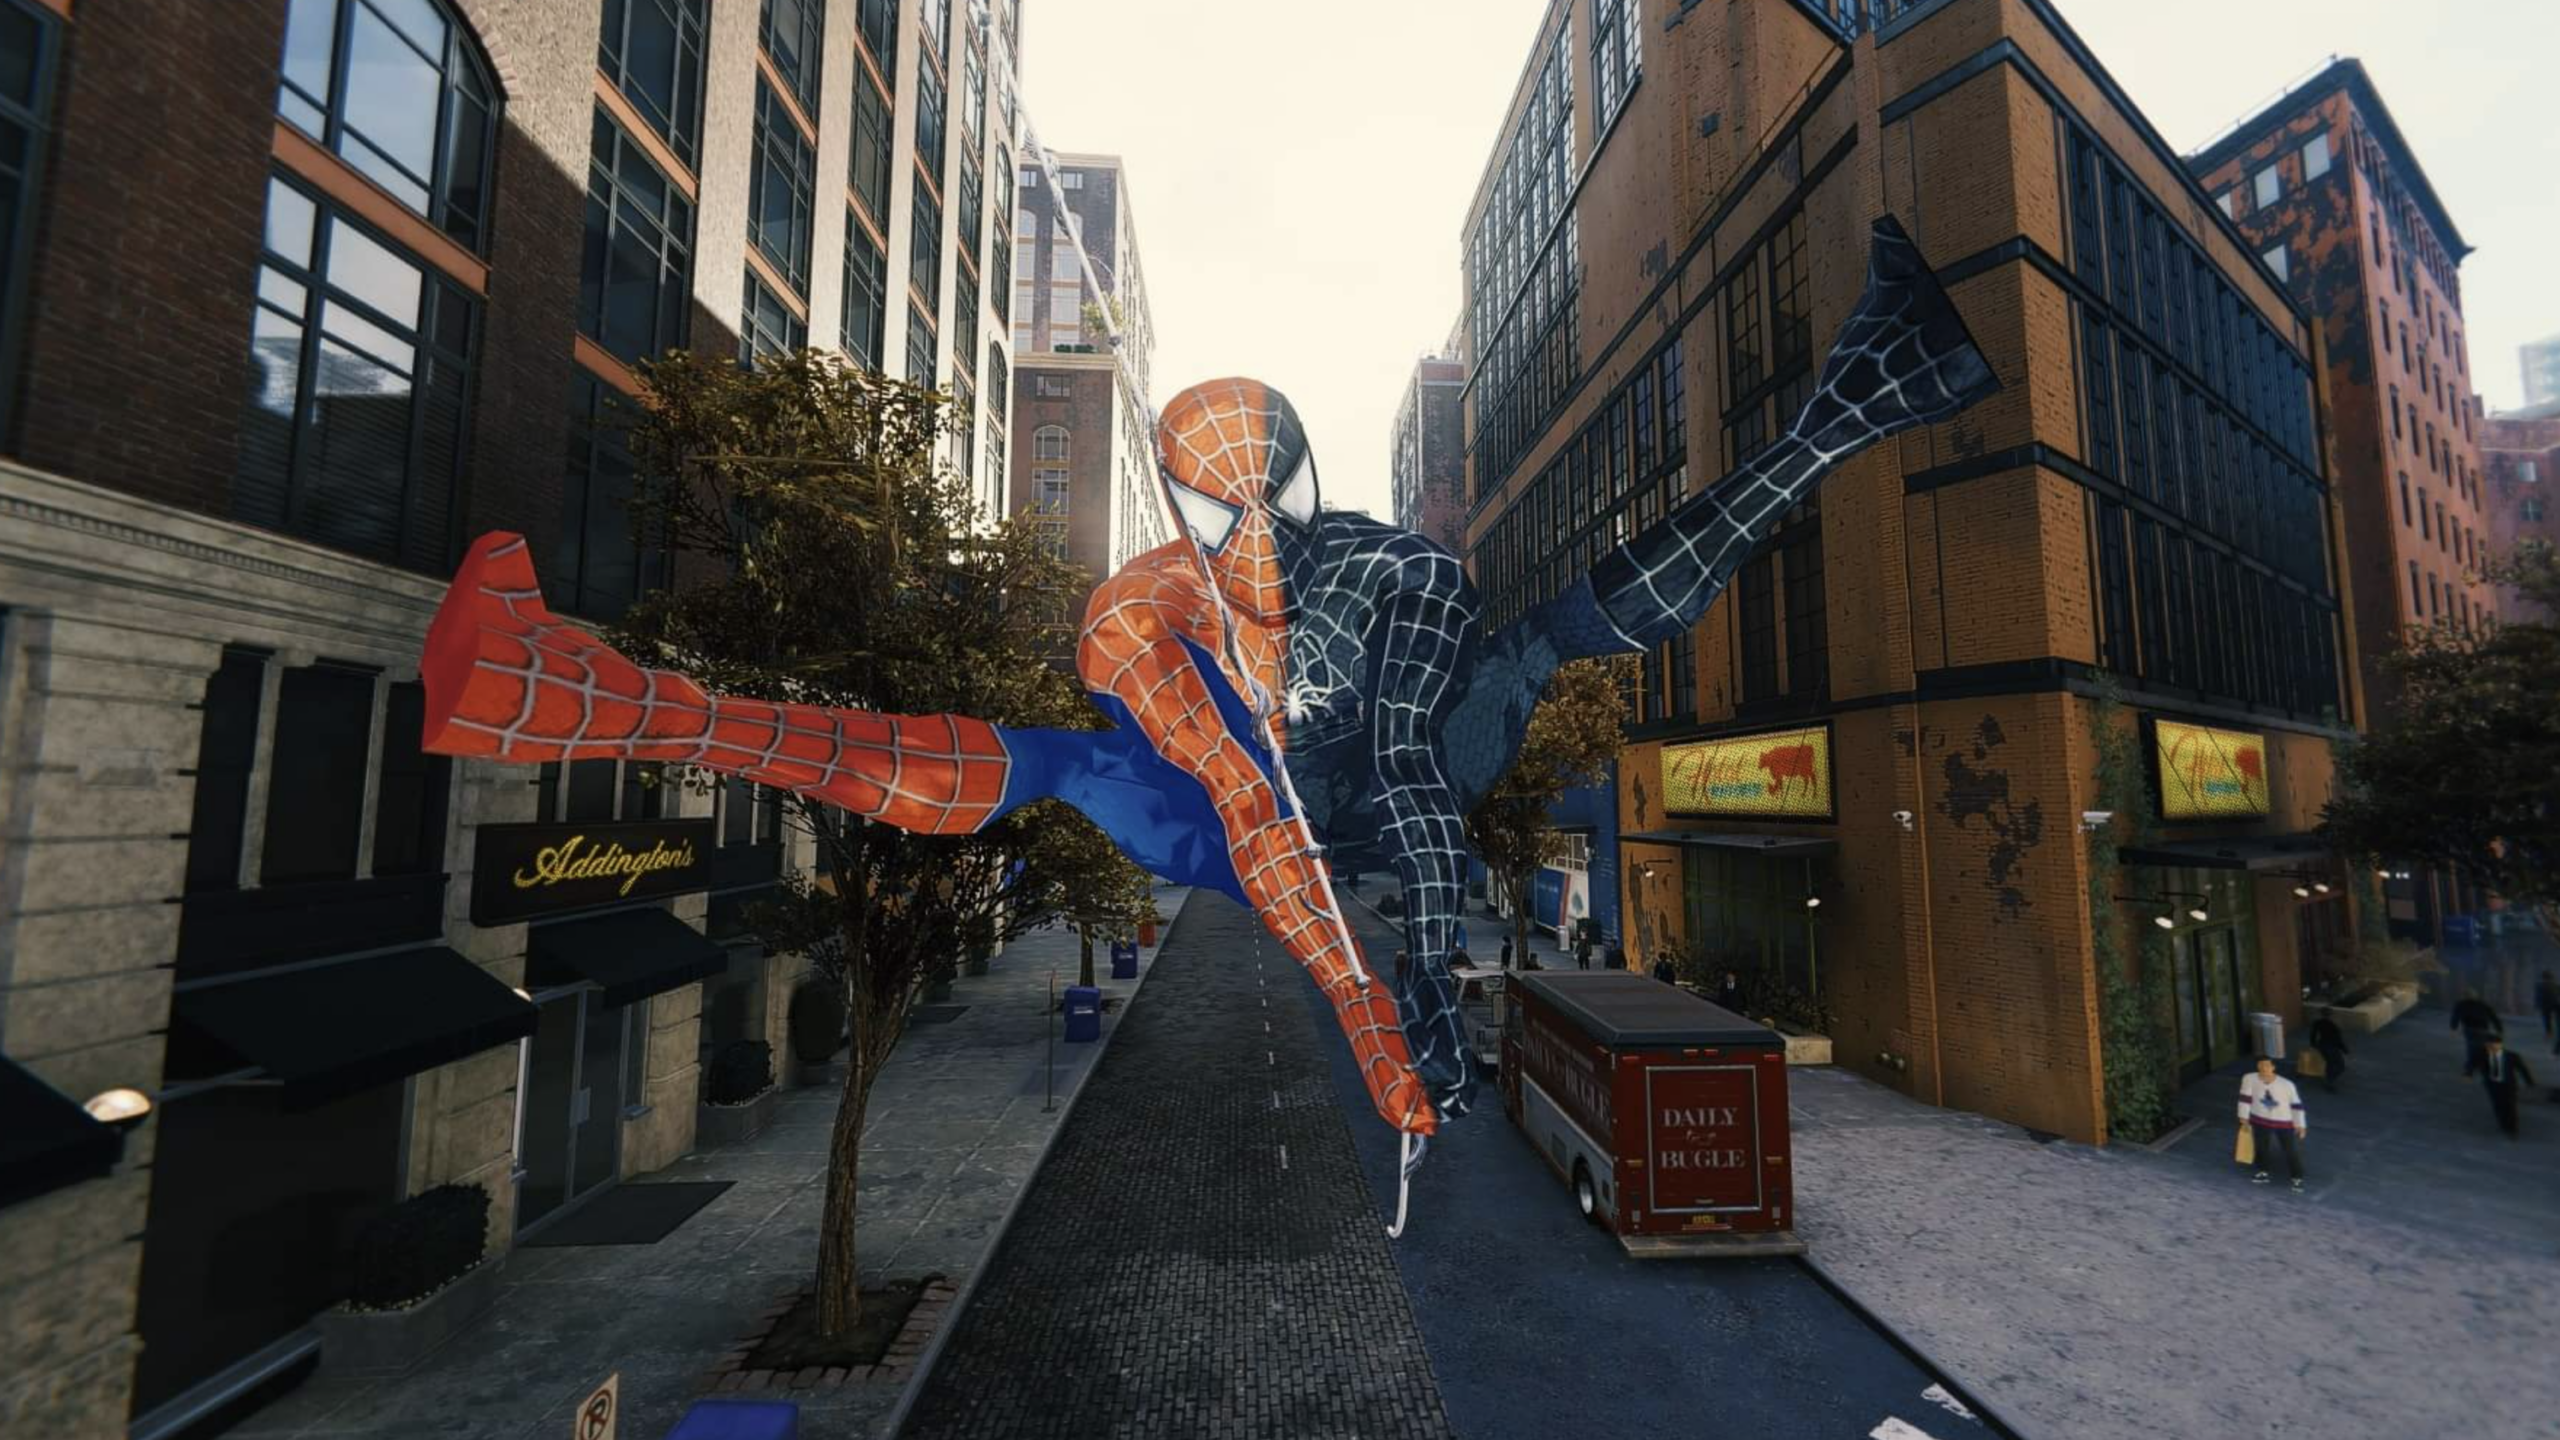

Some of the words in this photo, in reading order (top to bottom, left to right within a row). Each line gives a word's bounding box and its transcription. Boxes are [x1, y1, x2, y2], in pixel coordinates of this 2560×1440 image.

[513, 835, 695, 896] Addington's
[1663, 1107, 1738, 1127] DAILY
[1661, 1150, 1746, 1169] BUGLE
